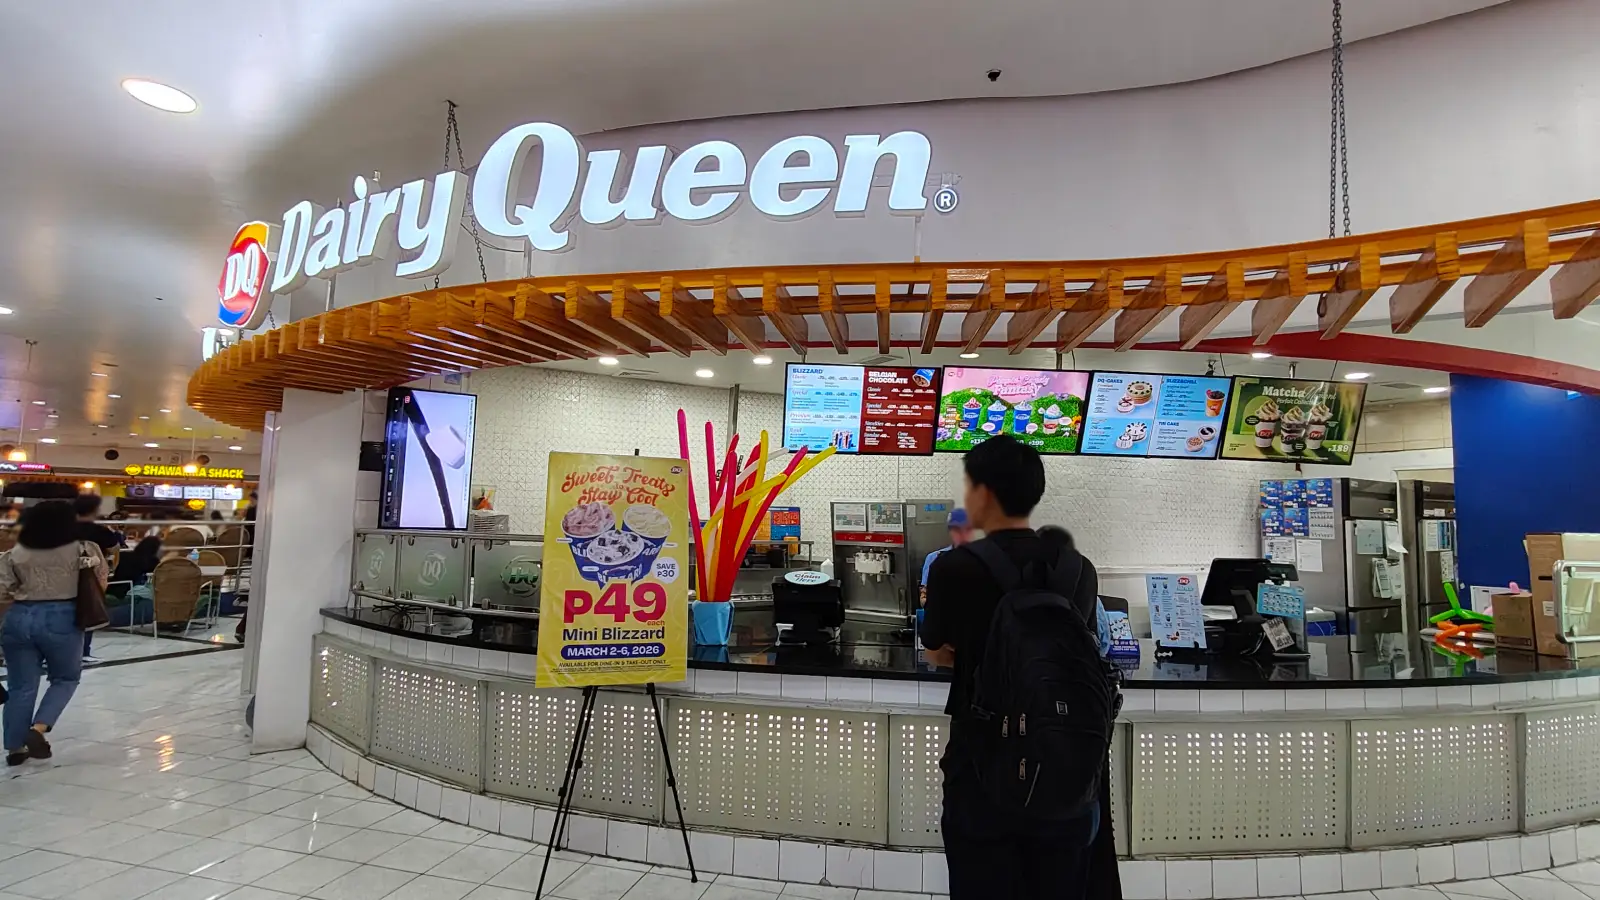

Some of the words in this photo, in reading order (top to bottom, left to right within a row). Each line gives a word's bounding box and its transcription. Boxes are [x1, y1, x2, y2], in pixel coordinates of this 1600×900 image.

[270, 171, 458, 293] Dairy
[471, 121, 933, 252] Queen
[223, 242, 262, 302] DQ
[868, 377, 909, 385] CHOCOLATE
[1262, 385, 1305, 398] Matcha
[208, 468, 244, 479] SHACK
[561, 466, 620, 493] Sweet
[623, 466, 676, 497] Treats
[626, 487, 660, 506] Cool
[423, 559, 441, 580] DQ
[562, 627, 598, 641] Mini
[601, 626, 665, 641] Blizzard
[567, 647, 608, 657] MARCH
[609, 648, 631, 656] 2-6,
[631, 645, 660, 655] 2026
